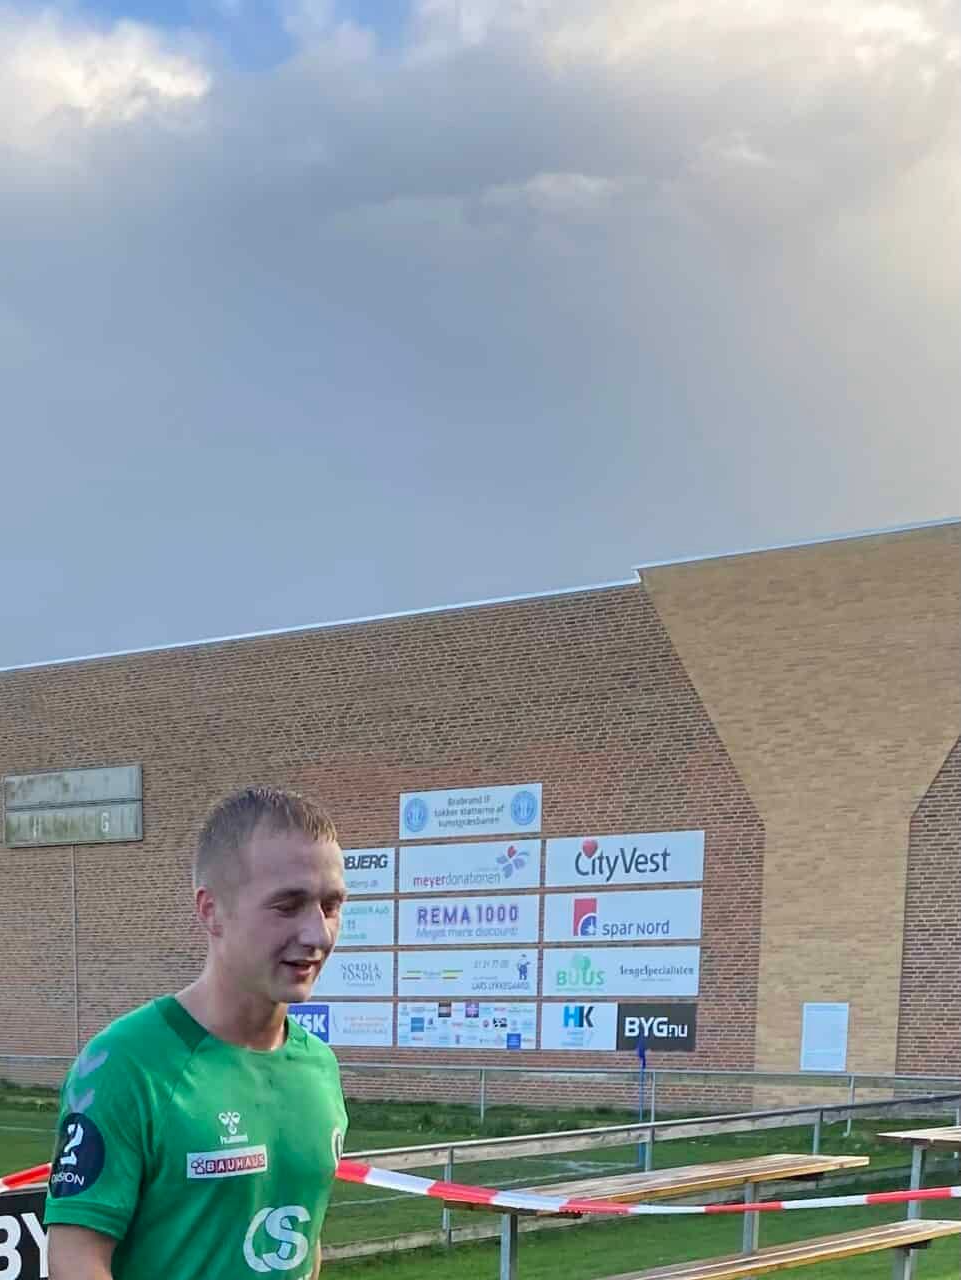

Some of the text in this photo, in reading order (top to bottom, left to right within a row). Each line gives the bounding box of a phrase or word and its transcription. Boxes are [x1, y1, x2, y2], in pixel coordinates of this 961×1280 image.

[343, 854, 389, 870] BJERG
[575, 846, 671, 882] CityVest
[418, 904, 519, 924] REMA 1000
[563, 1006, 595, 1028] HK
[206, 1154, 265, 1173] BAUHAUS
